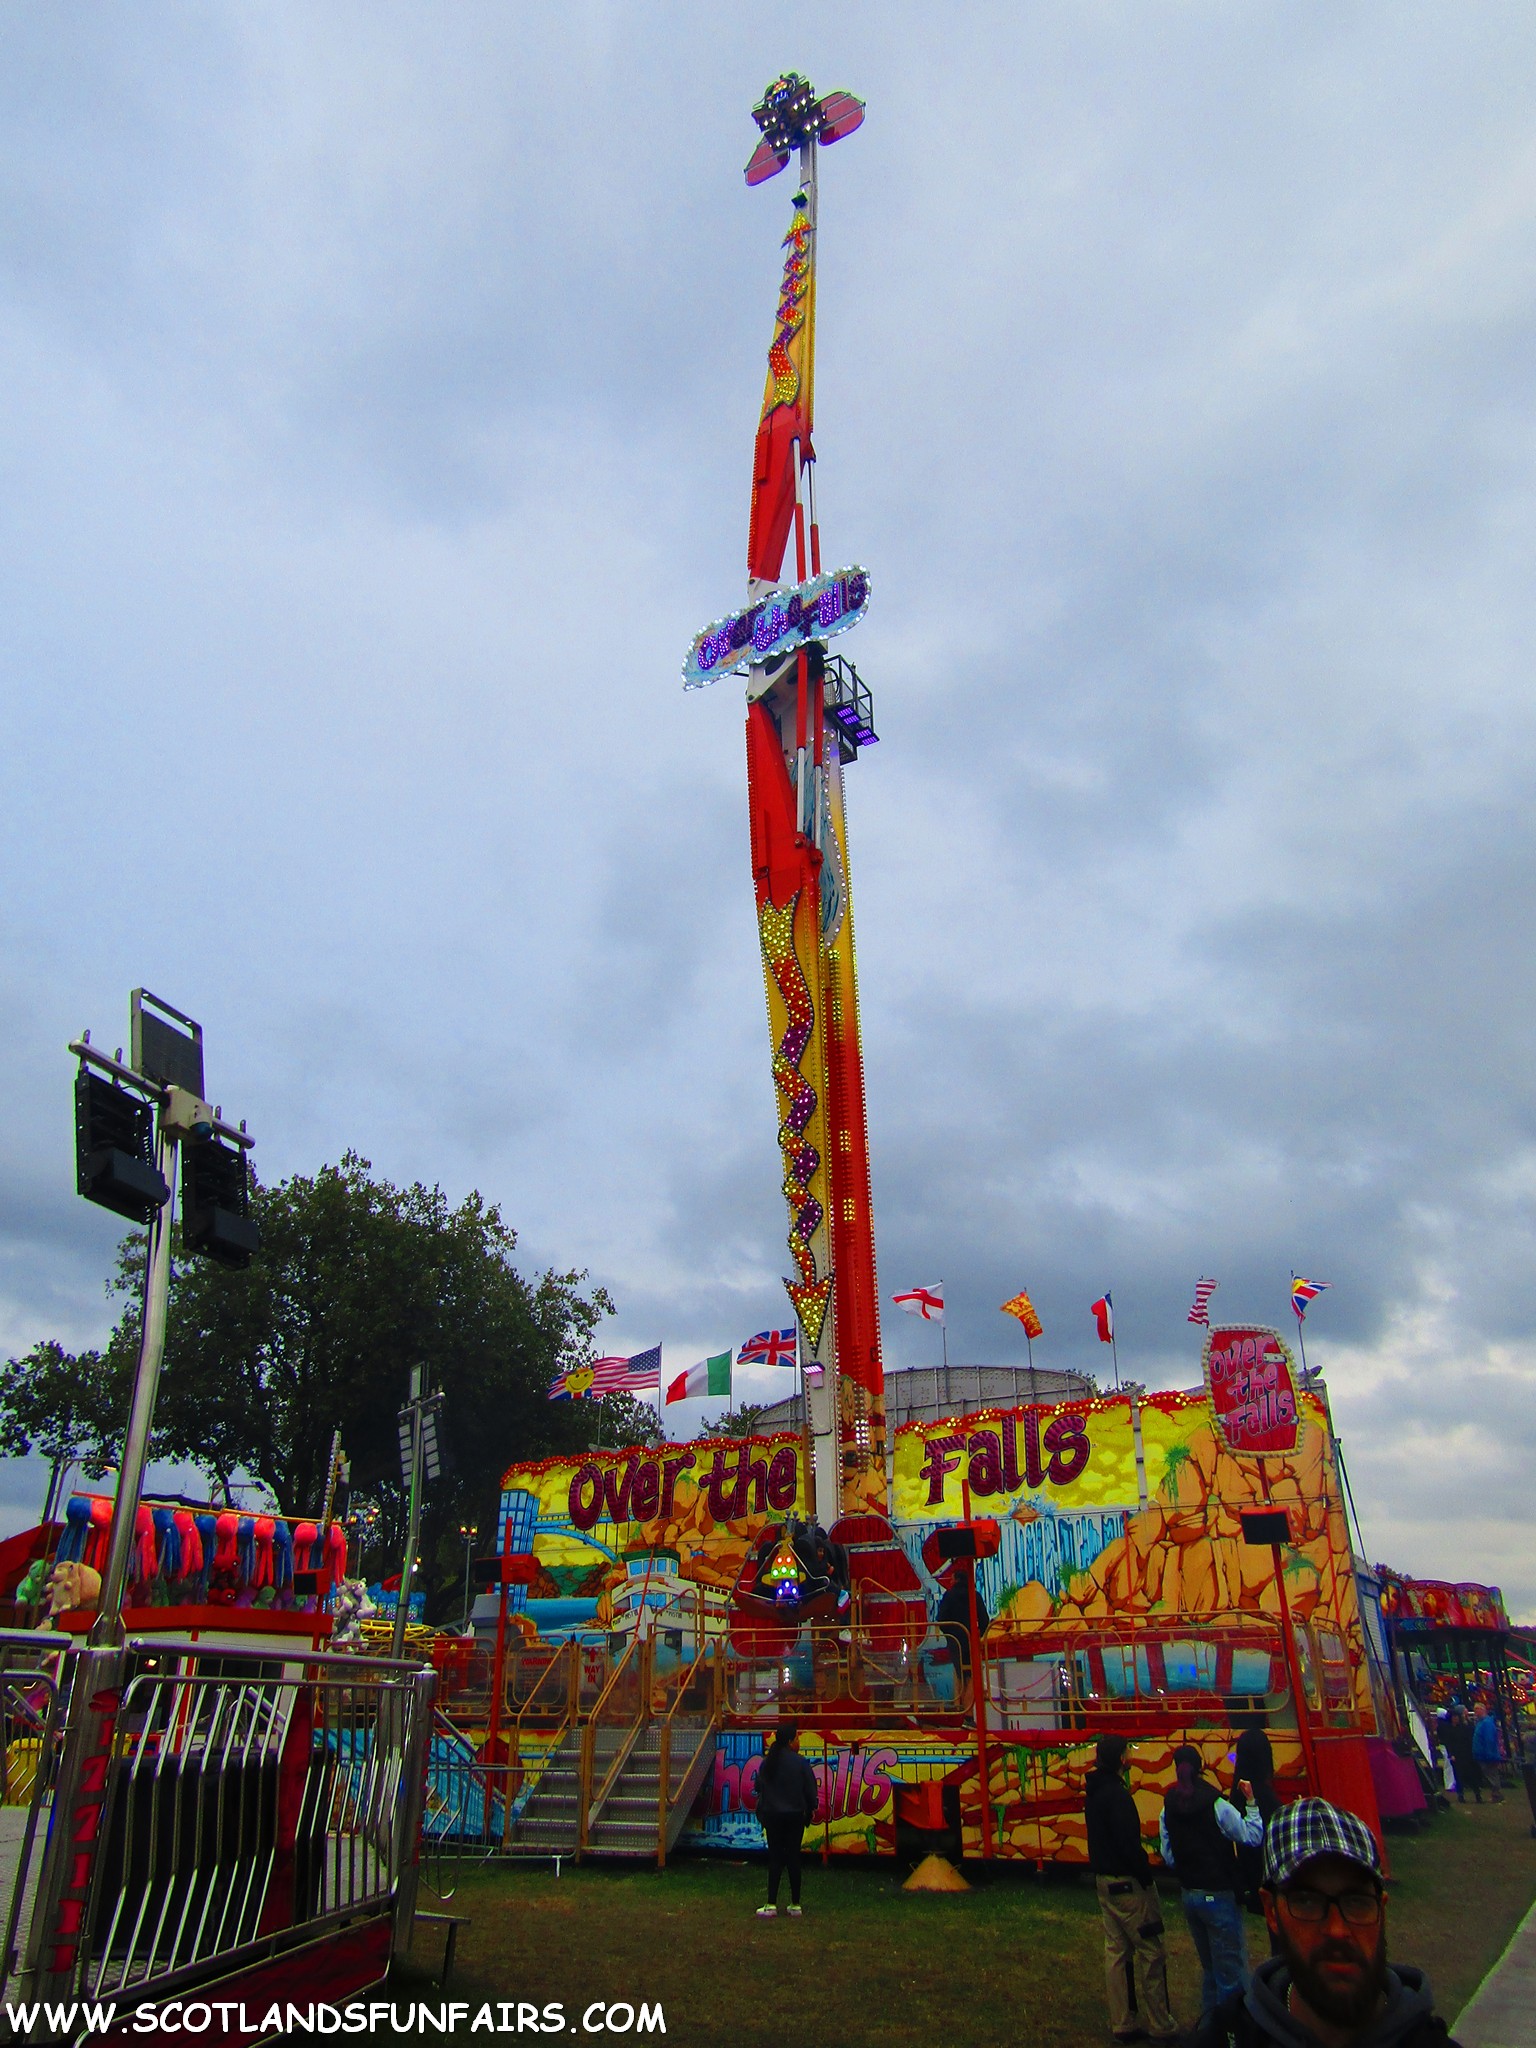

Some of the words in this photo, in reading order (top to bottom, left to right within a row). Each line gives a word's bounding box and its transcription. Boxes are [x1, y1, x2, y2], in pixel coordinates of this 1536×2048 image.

[1226, 1364, 1279, 1405] the
[1226, 1390, 1294, 1445] Falls
[699, 1443, 798, 1523] the
[919, 1408, 1091, 1507] Falls
[584, 1665, 600, 1674] WAY
[587, 1674, 596, 1683] IN
[810, 1746, 899, 1826] alls
